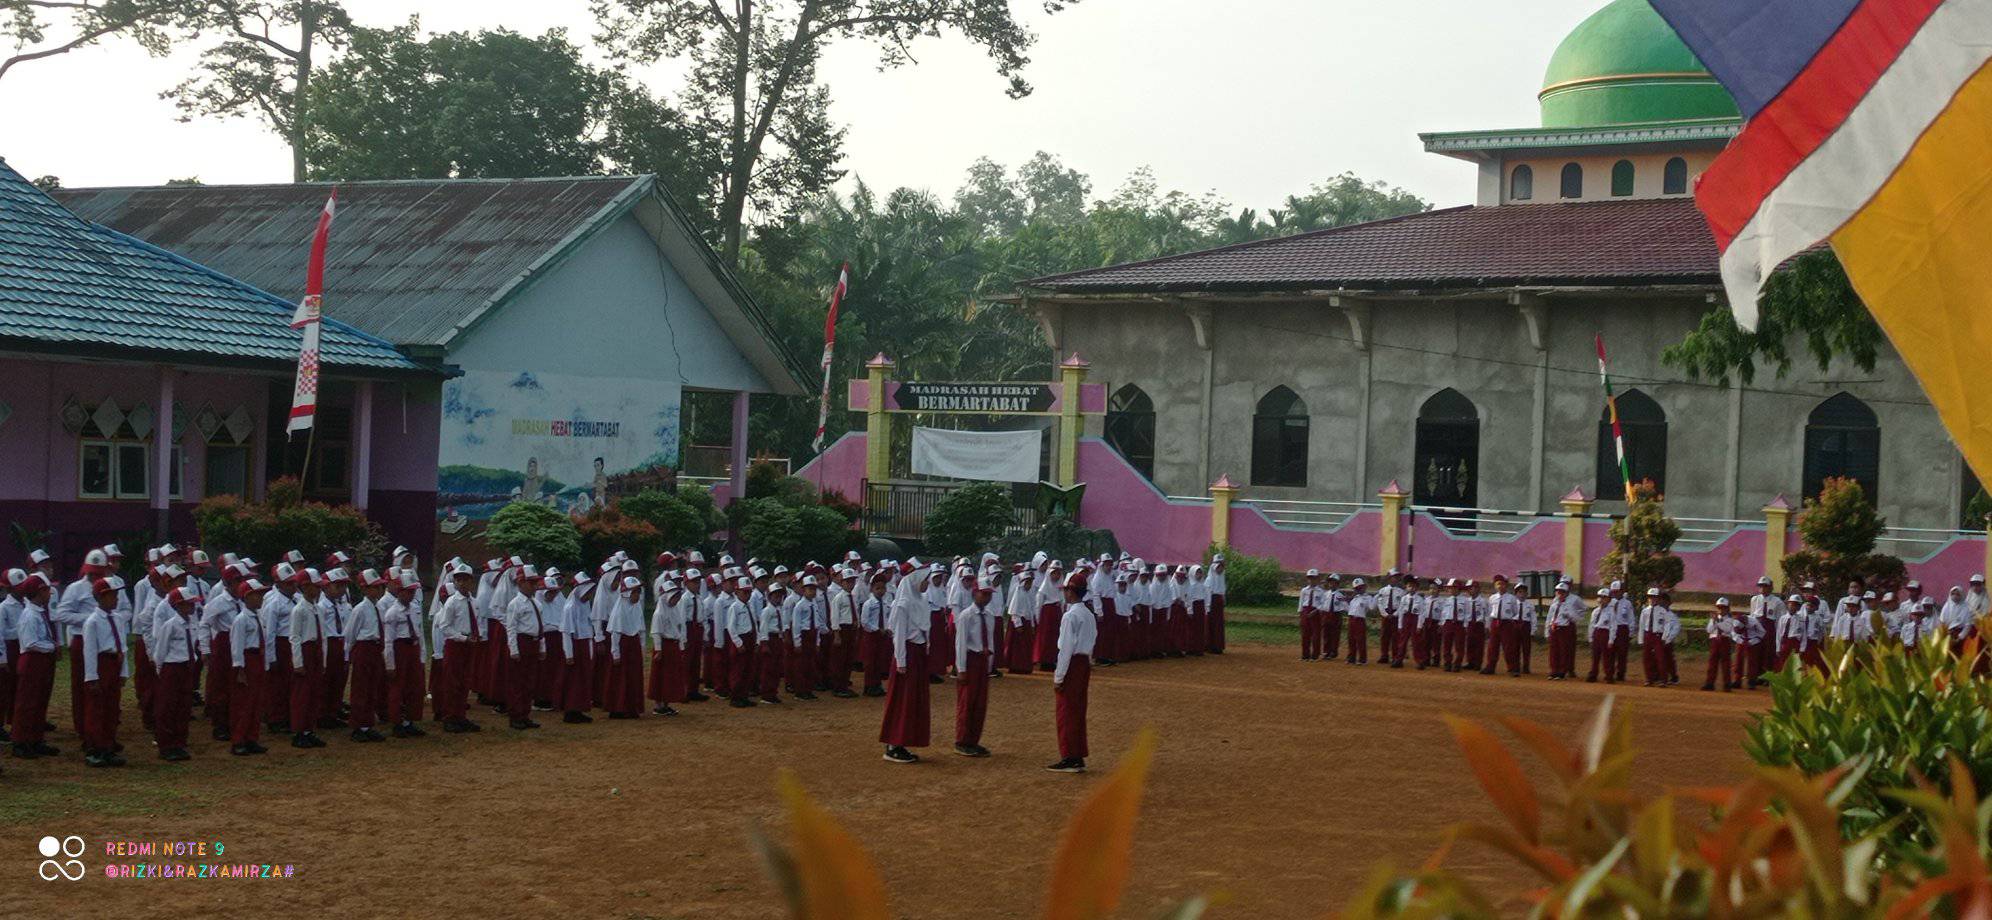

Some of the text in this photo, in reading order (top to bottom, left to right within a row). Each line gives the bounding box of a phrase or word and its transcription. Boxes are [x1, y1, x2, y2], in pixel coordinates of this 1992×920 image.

[910, 385, 1039, 395] MADRASAH HEBAT
[918, 396, 1030, 411] BERMARTABAT
[551, 420, 572, 436] HEBAT
[573, 421, 620, 437] BERMARTABAT
